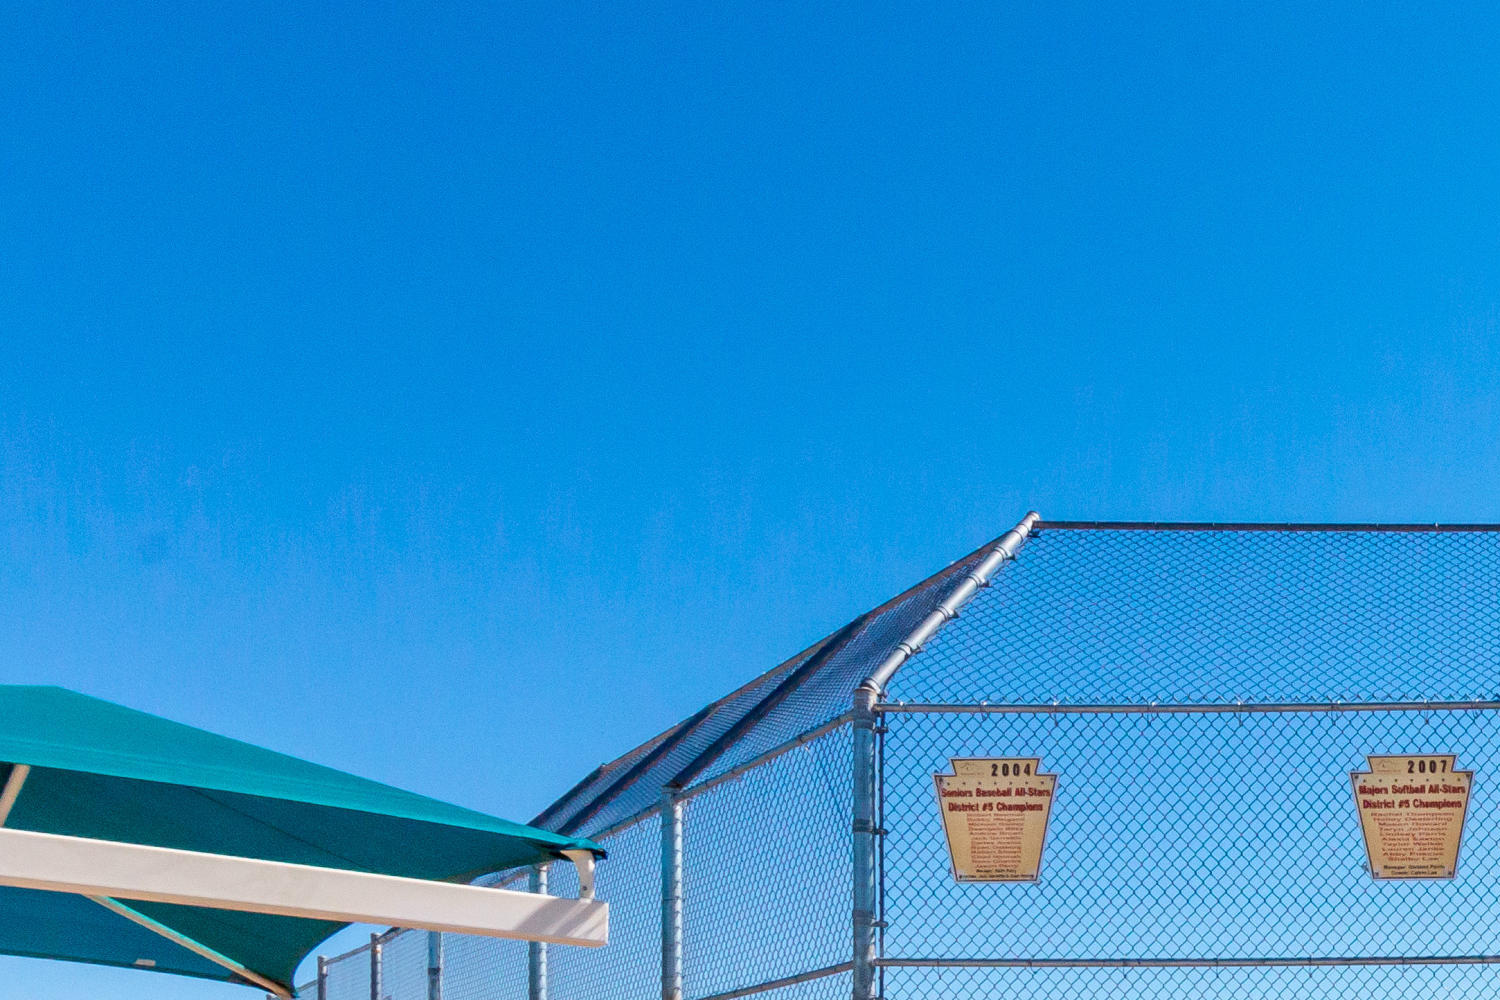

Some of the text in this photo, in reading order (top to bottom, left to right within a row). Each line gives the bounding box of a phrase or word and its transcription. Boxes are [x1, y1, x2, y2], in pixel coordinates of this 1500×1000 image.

[991, 763, 1031, 777] 2004
[1407, 760, 1447, 774] 2007
[941, 787, 1051, 798] Seniors Baseball All-Stars
[1359, 784, 1466, 796] Majors Softball All-Stars
[948, 802, 1043, 813] District #5 Champions
[1363, 799, 1462, 810] District #5 Champions
